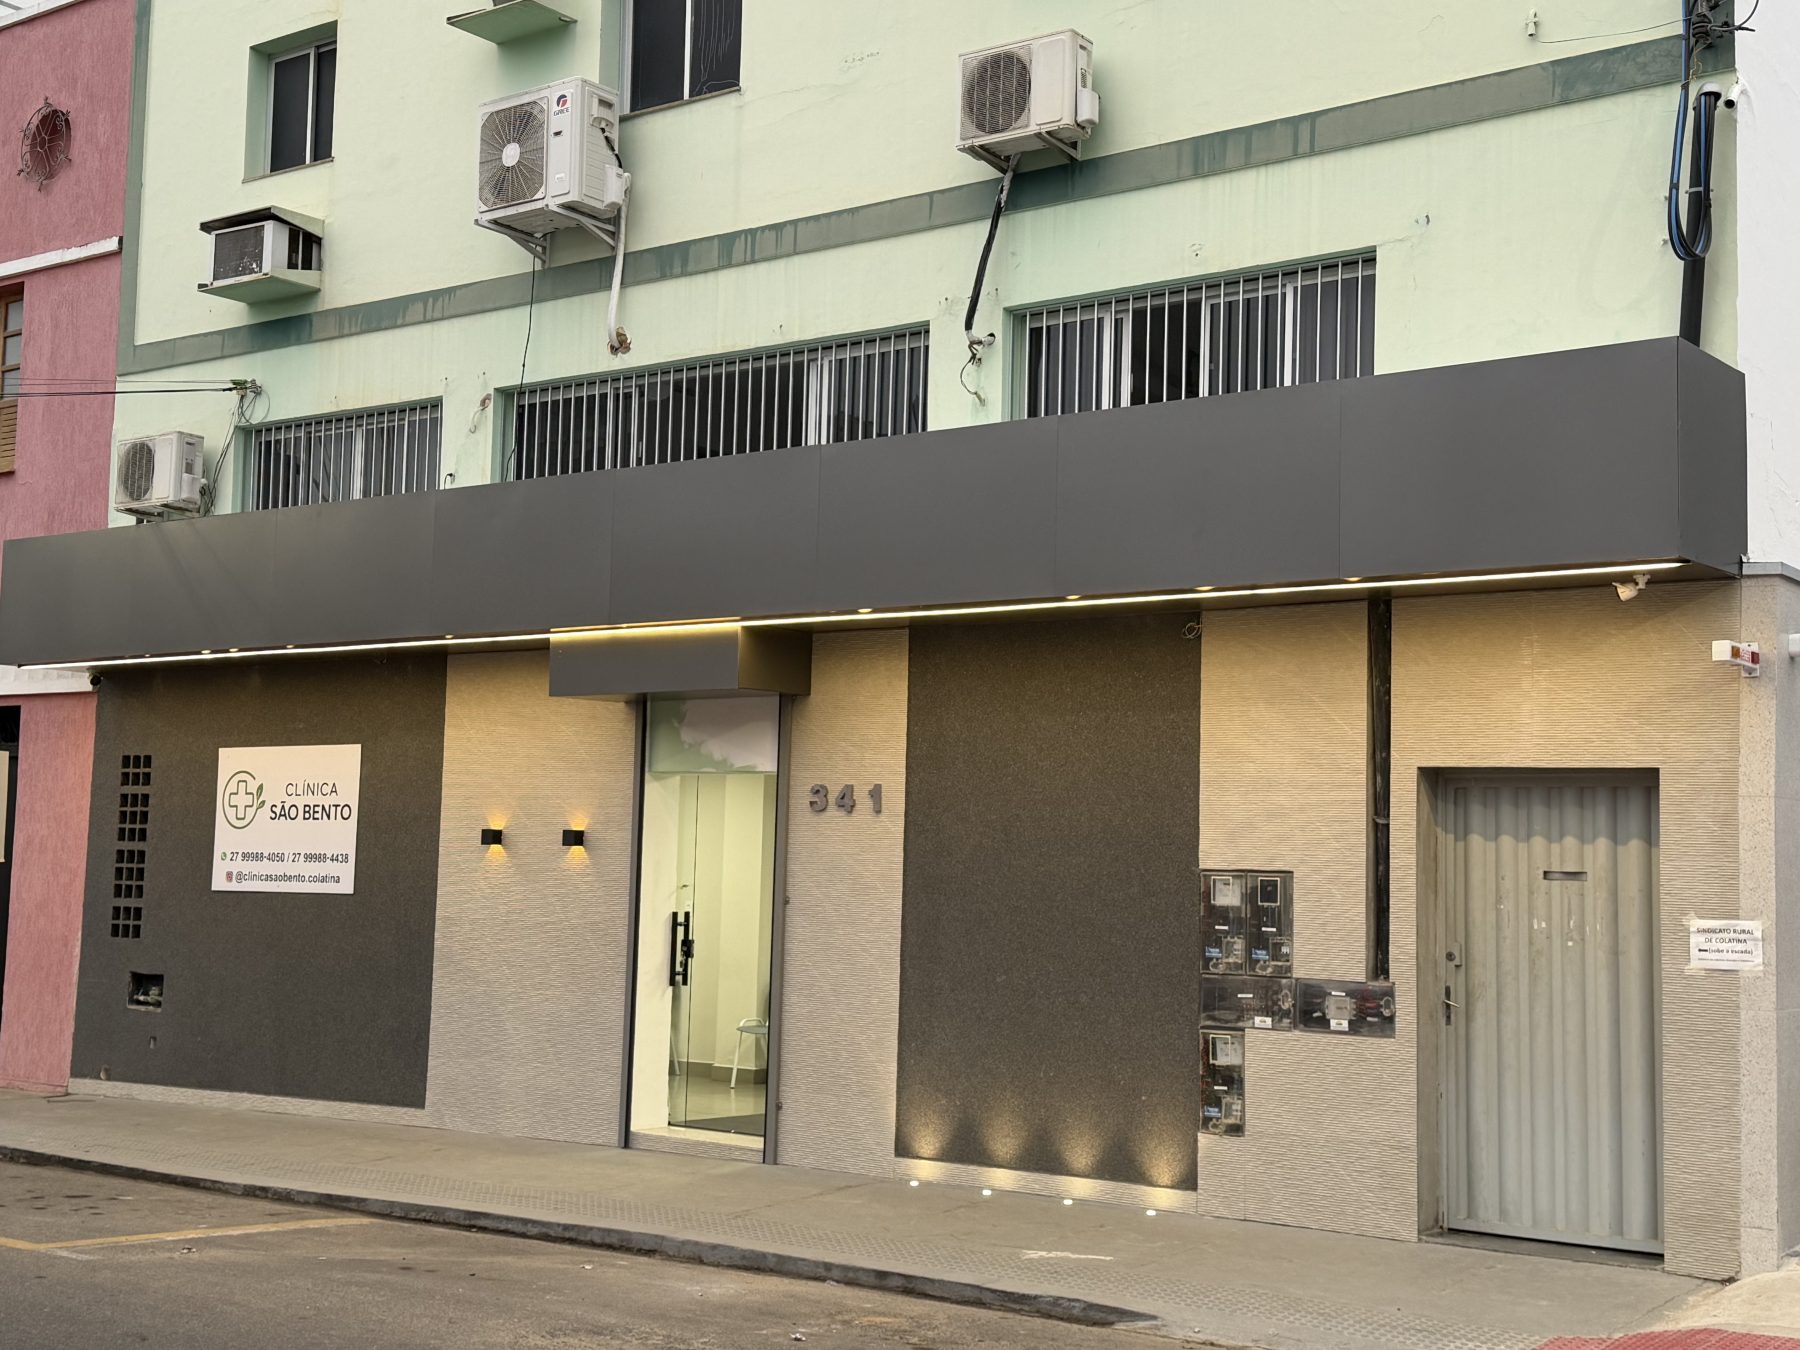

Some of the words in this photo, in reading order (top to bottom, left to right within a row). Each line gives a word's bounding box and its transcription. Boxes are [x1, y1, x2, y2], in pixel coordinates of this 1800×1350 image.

[285, 779, 338, 796] CLÍNICA
[809, 783, 882, 814] 341
[269, 801, 299, 821] SÃO
[302, 804, 352, 821] BENTO
[229, 851, 239, 862] 27
[241, 852, 285, 863] 99988-4050
[291, 853, 301, 863] 27
[303, 853, 349, 864] 99988-4438
[235, 871, 341, 884] @clinicasaobento.colatina
